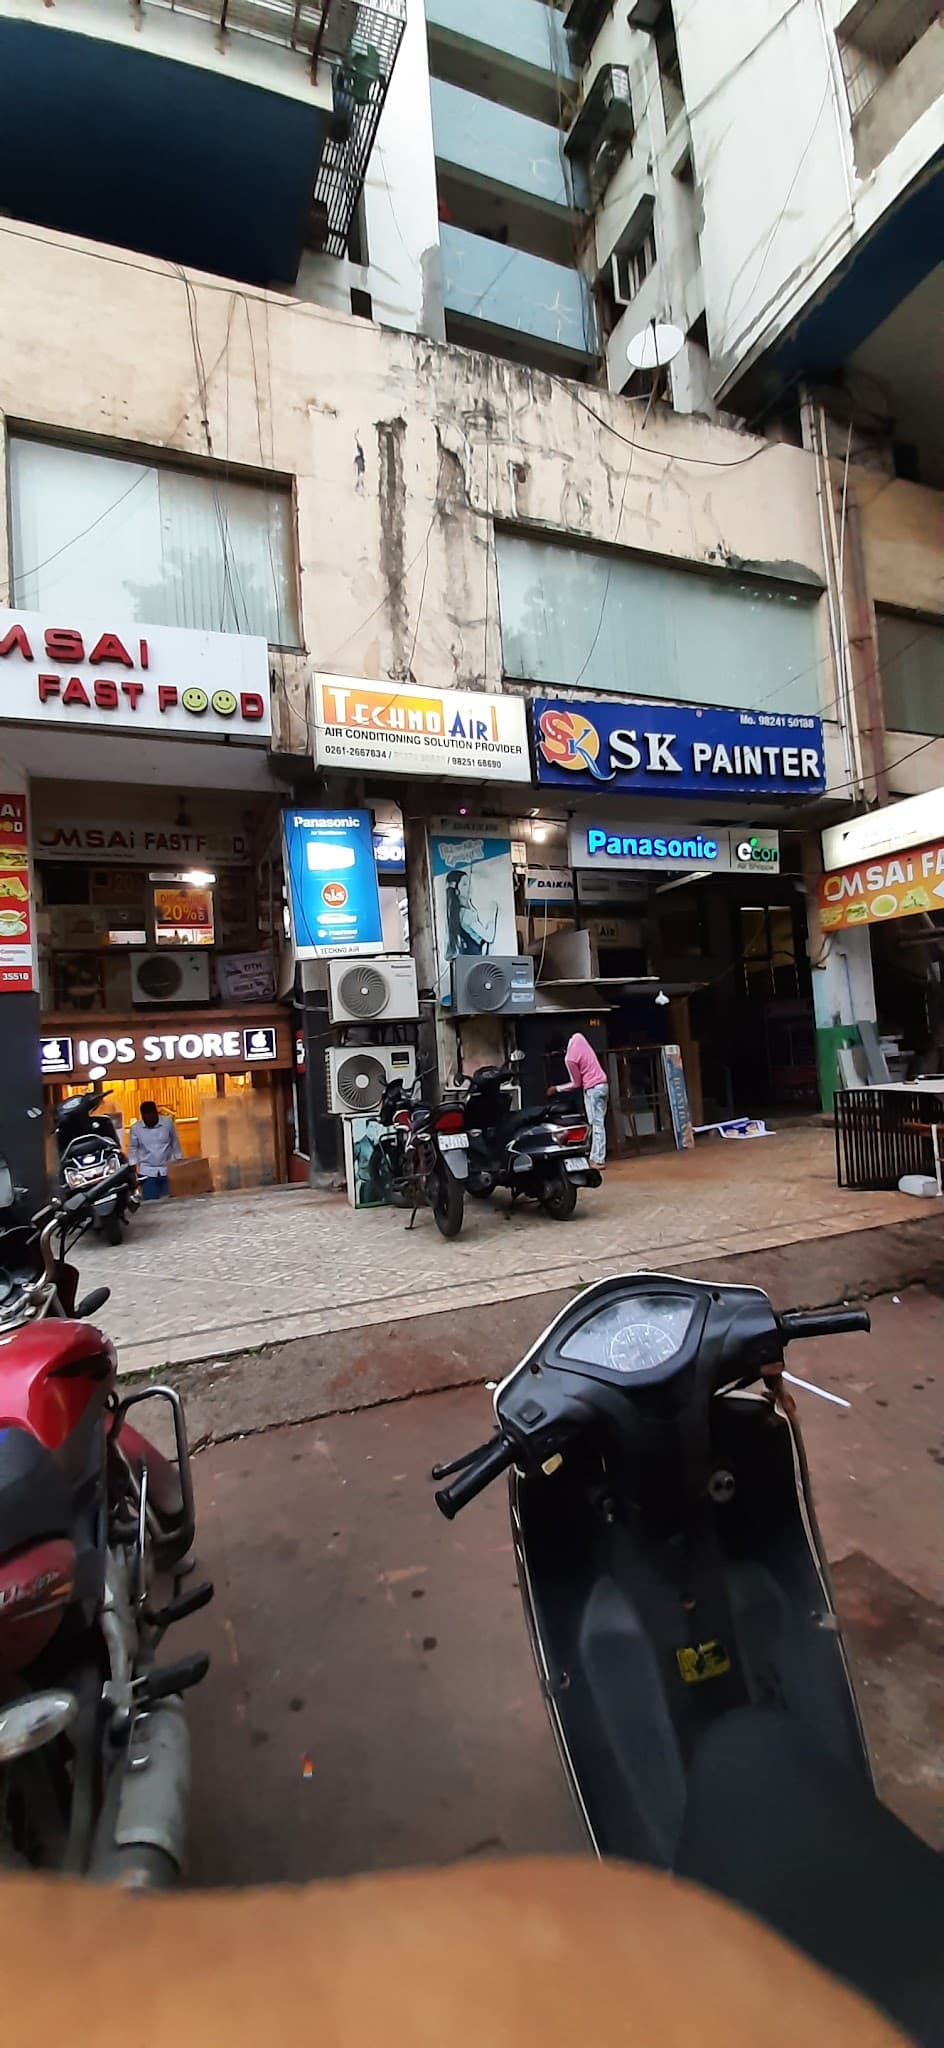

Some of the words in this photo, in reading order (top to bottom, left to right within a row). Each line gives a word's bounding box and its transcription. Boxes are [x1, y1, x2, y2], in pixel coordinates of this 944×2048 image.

[38, 674, 144, 711] FAST
[328, 687, 443, 735] TECHNO
[449, 709, 489, 742] AIR
[325, 726, 343, 738] AIR
[345, 728, 422, 746] CONDITIONING
[424, 737, 473, 751] SOLUTION
[475, 741, 523, 755] PROVIDER
[609, 729, 683, 773] SK
[693, 742, 822, 779] PAINTER
[294, 815, 361, 828] Panasonic
[144, 832, 193, 852] FAST
[586, 829, 718, 859] Panasonic
[537, 880, 575, 889] DAIKIN
[824, 871, 865, 902] OM
[162, 904, 198, 921] 20%
[320, 946, 347, 954] TECHNO
[79, 1037, 136, 1066] IOS
[142, 1031, 241, 1062] STORE
